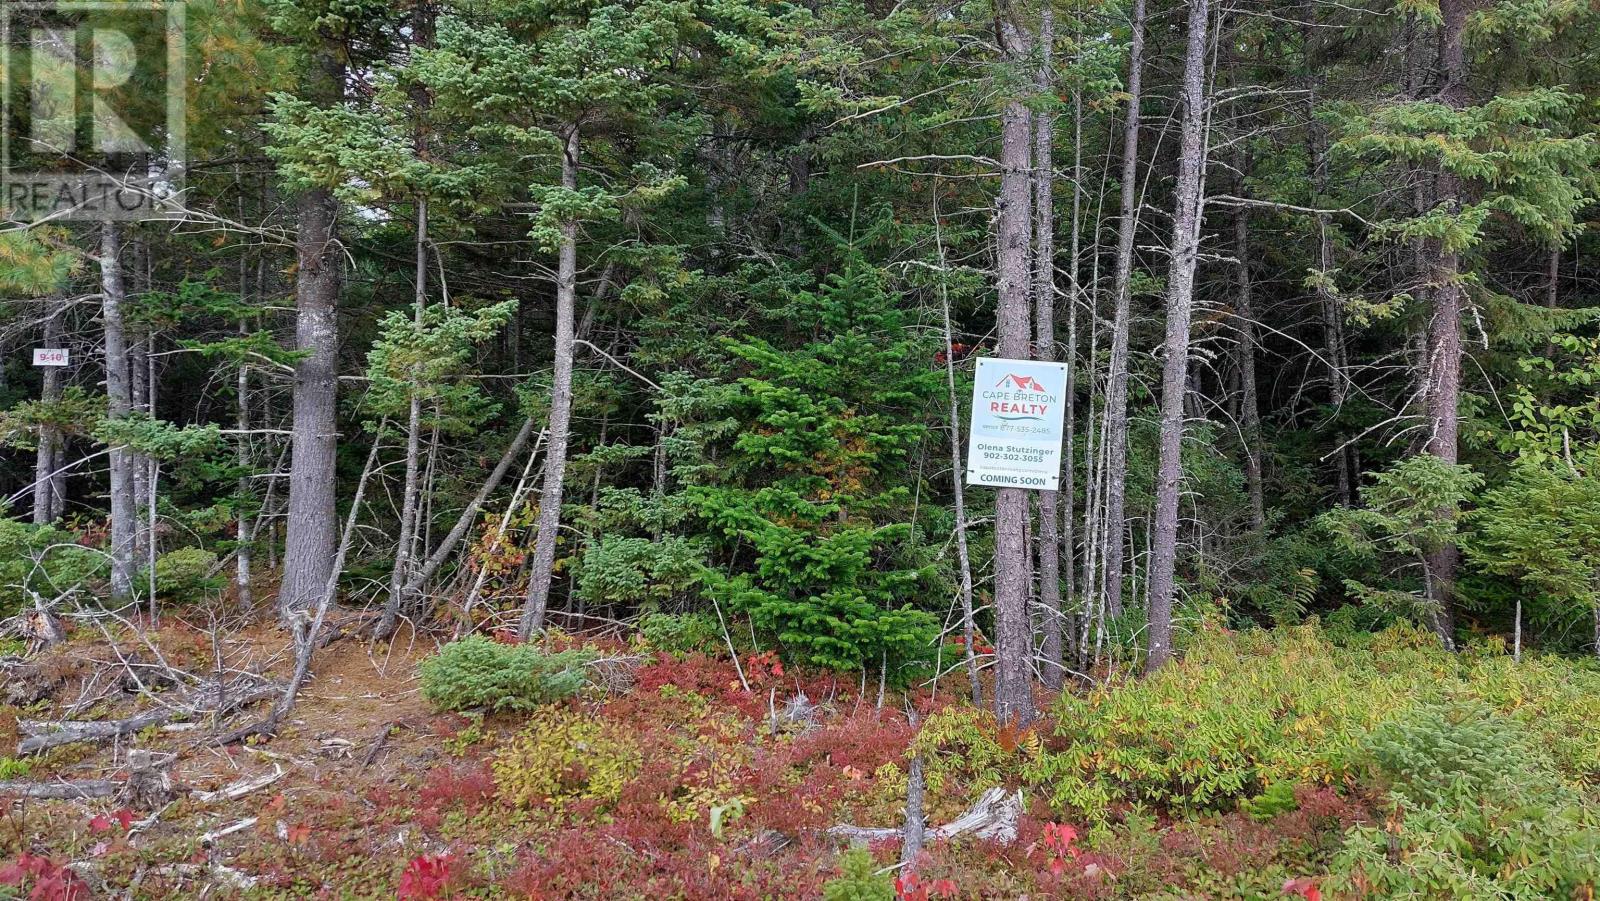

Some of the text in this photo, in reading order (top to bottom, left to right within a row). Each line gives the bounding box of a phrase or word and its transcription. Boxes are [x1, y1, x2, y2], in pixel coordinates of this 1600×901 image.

[982, 390, 1056, 403] CAPE BRETON
[990, 401, 1048, 415] REALTY
[977, 443, 1054, 456] Olena Stutzinger
[983, 452, 1044, 463] 902-302-3055
[980, 474, 1046, 486] COMING SOON
